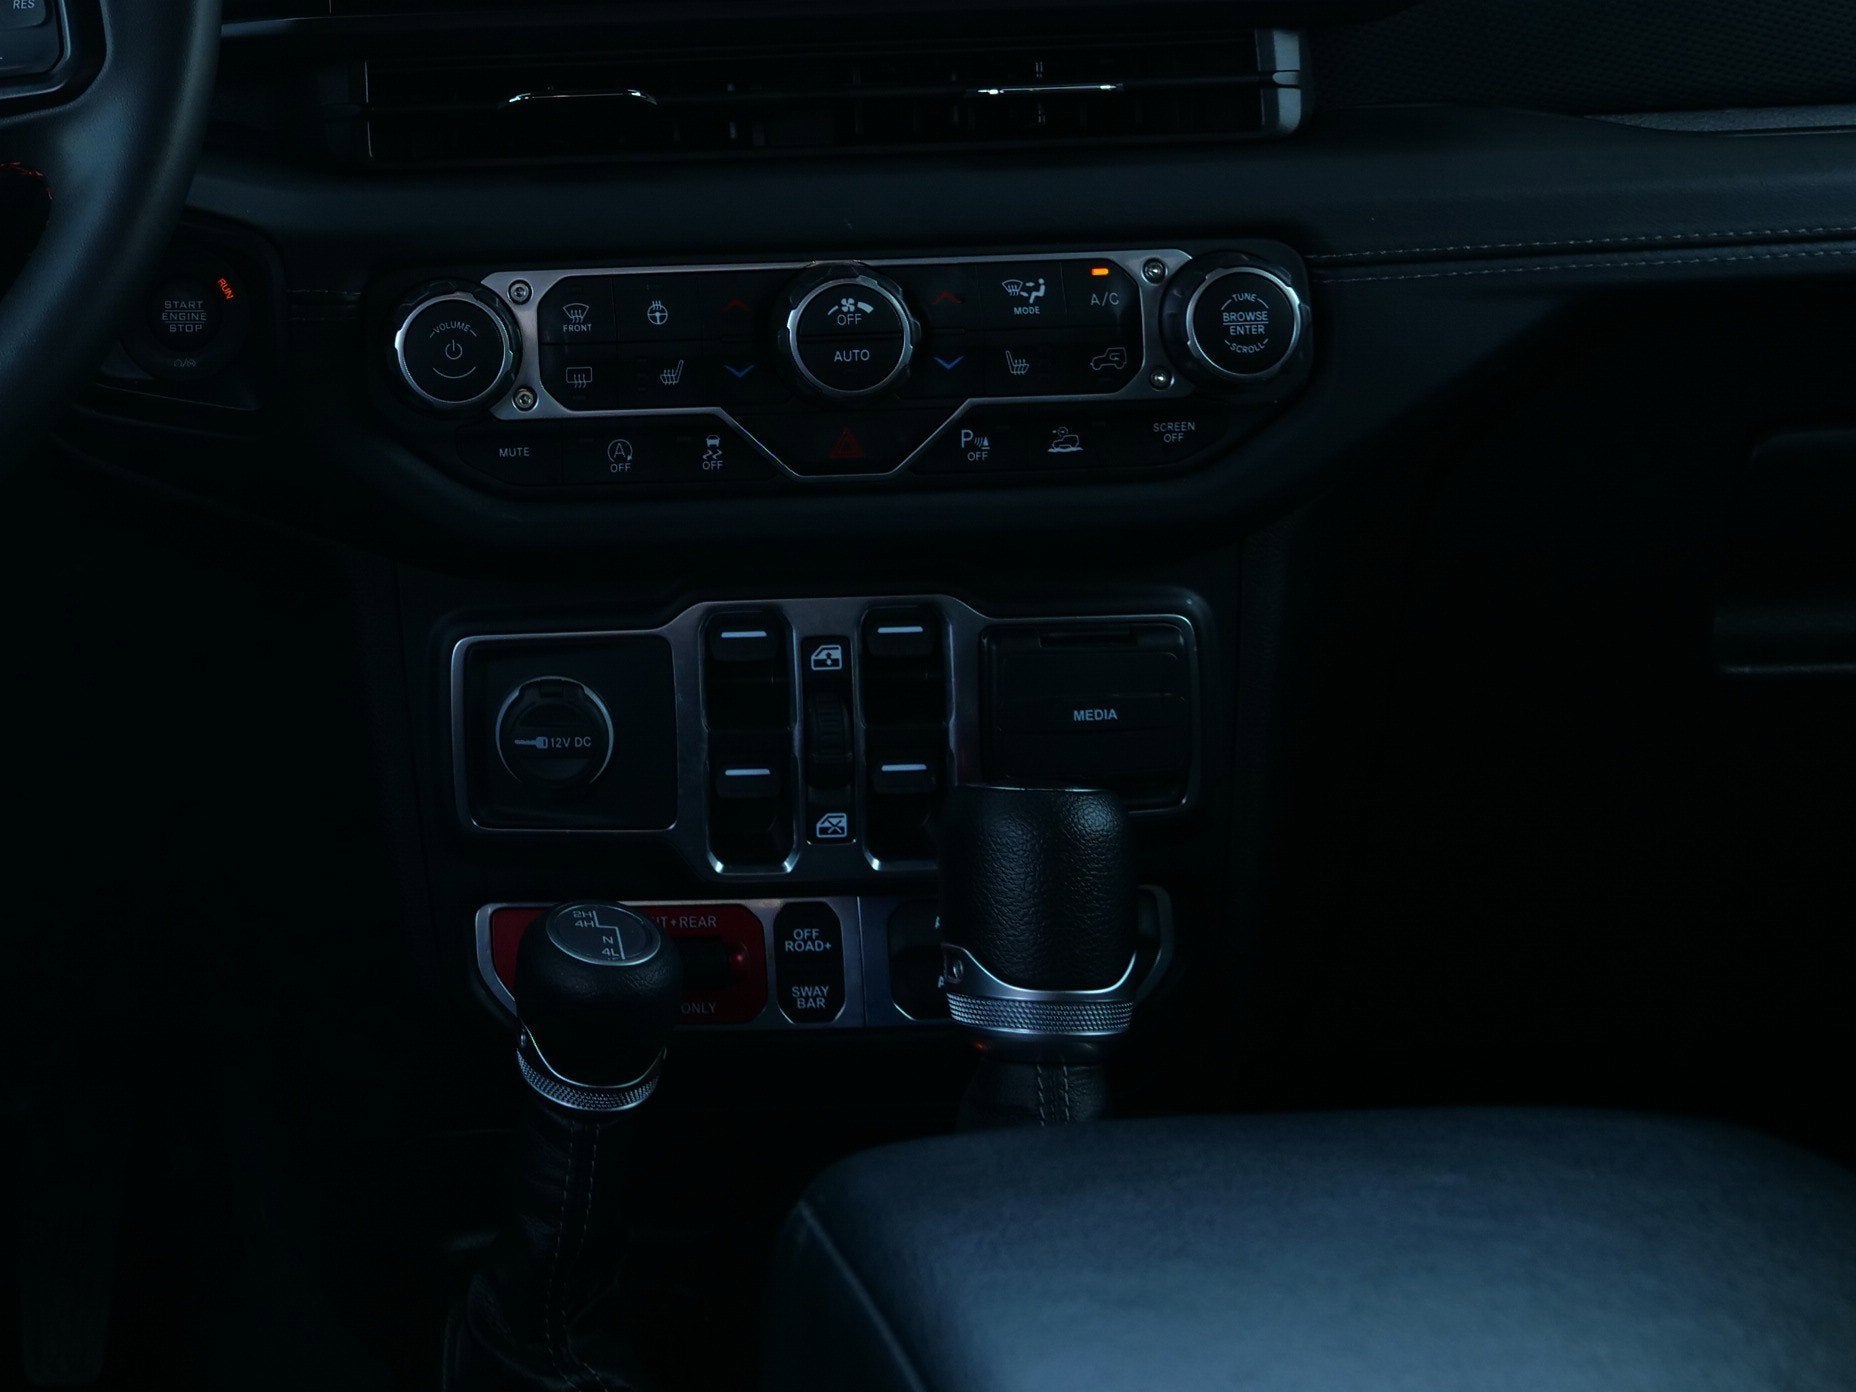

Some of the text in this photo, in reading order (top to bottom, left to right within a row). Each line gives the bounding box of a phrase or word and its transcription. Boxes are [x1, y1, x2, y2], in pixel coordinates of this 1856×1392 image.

[12, 0, 35, 9] RES
[217, 276, 234, 300] RUN
[1090, 292, 1120, 306] A/C
[1232, 292, 1257, 302] TUNE
[164, 300, 204, 309] START
[1013, 306, 1040, 315] MODE
[161, 312, 207, 321] ENGINE
[836, 313, 863, 327] OFF
[1223, 311, 1268, 322] BROWSE
[169, 324, 203, 333] STOP
[433, 320, 471, 333] VOLUME
[562, 323, 592, 333] FRONT
[1229, 324, 1265, 336] ENTER
[1230, 342, 1265, 354] SCROLL
[834, 348, 871, 363] AUTO
[1152, 420, 1196, 433] SCREEN
[1163, 432, 1185, 444] OFF
[499, 447, 530, 458] MUTE
[967, 451, 988, 462] OFF
[610, 462, 631, 473] OFF
[702, 460, 723, 471] OFF
[1073, 707, 1118, 723] MEDIA
[550, 736, 592, 748] 12V DC
[574, 920, 594, 928] 4H
[656, 915, 717, 929] T+REAR
[793, 928, 820, 939] OFF
[603, 935, 614, 944] N
[784, 939, 832, 952] ROAD+
[601, 947, 620, 957] 4L
[791, 985, 830, 998] SWAY
[681, 1001, 718, 1014] ONLY
[796, 997, 827, 1009] BAR
